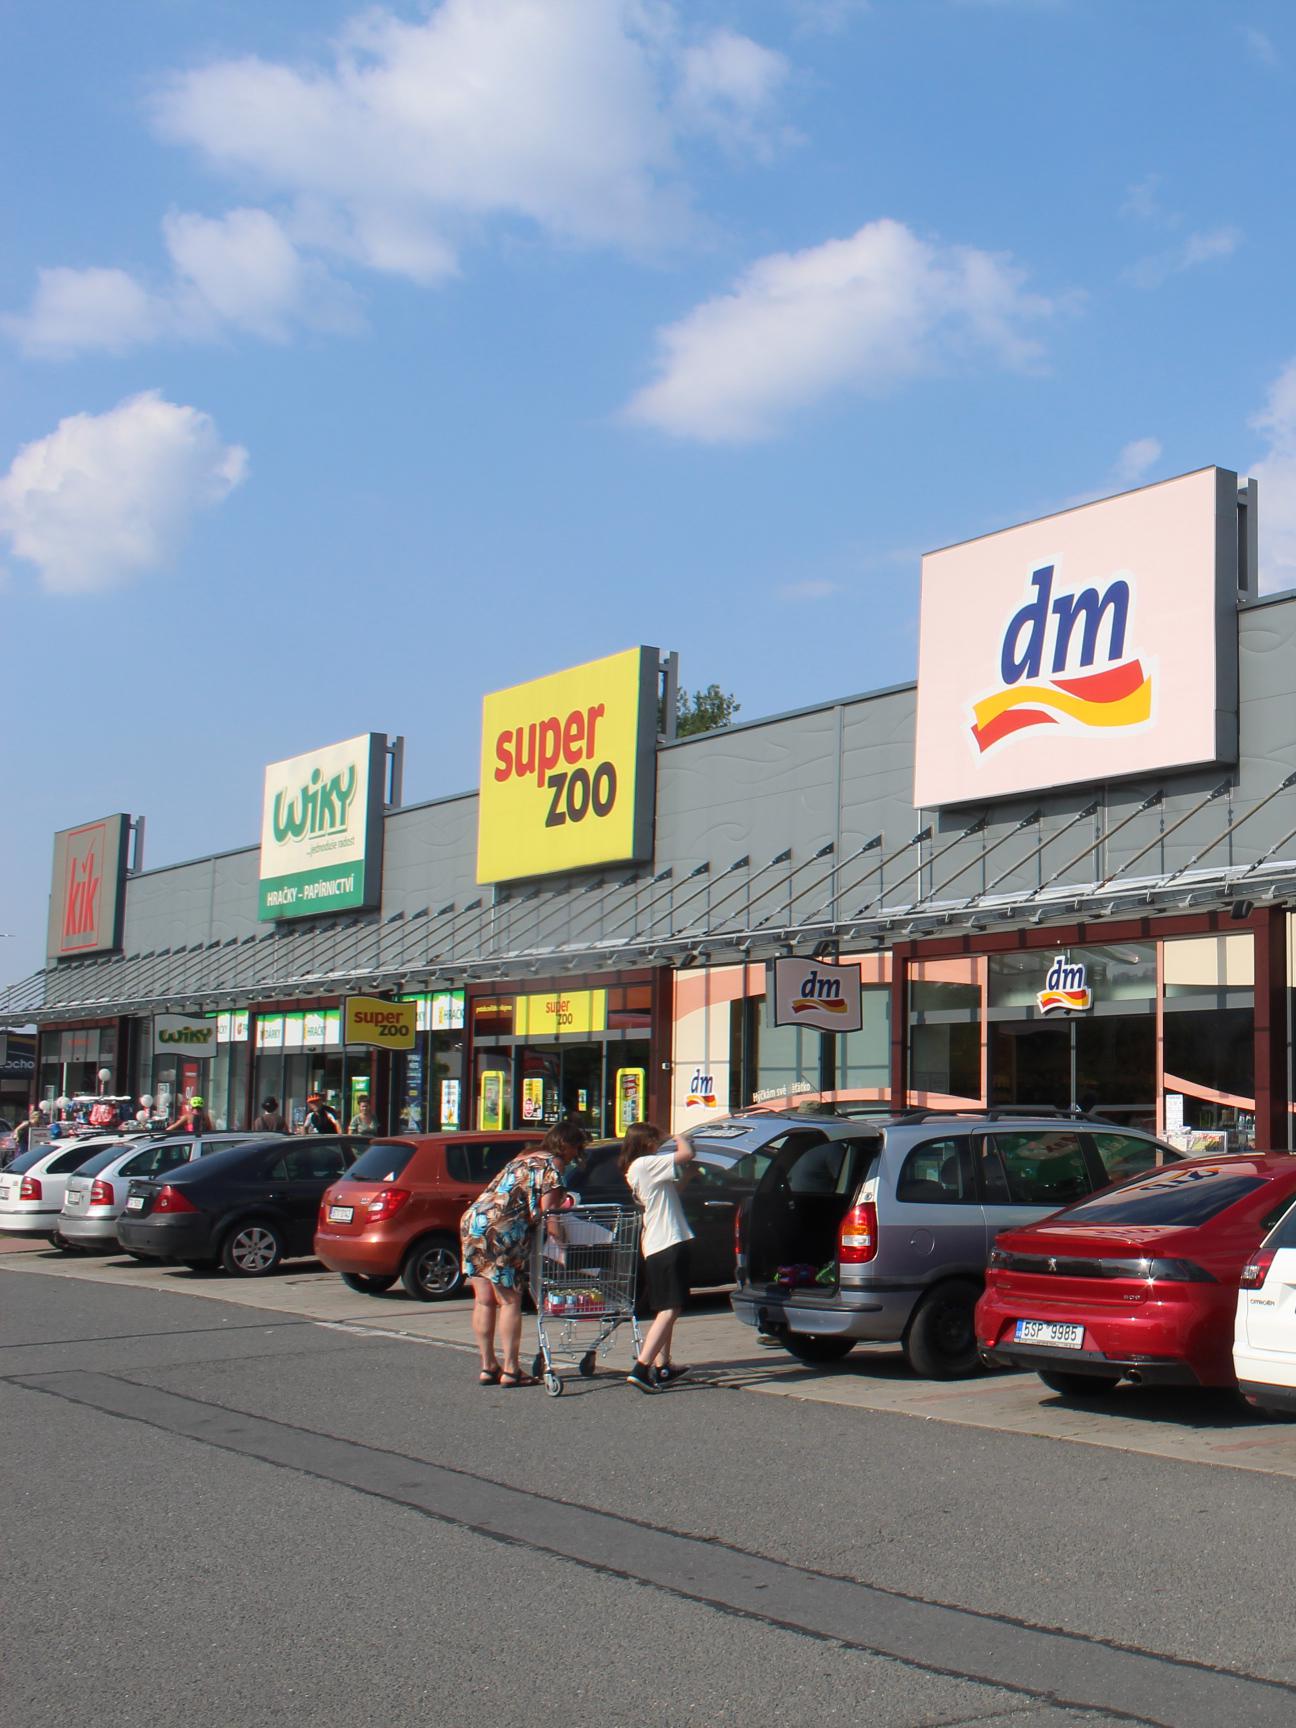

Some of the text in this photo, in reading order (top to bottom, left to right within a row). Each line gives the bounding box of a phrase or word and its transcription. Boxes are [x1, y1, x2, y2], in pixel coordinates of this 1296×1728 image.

[1000, 564, 1130, 685] dm
[494, 702, 606, 789] super
[266, 885, 298, 907] HRAČKY
[303, 873, 355, 903] PAPÍRNICTVÍ
[800, 970, 840, 999] dm
[1047, 957, 1085, 991] dm
[354, 1011, 404, 1027] super
[545, 1000, 571, 1016] super
[690, 1068, 713, 1094] dm
[1023, 1321, 1077, 1341] 5SP 9985
